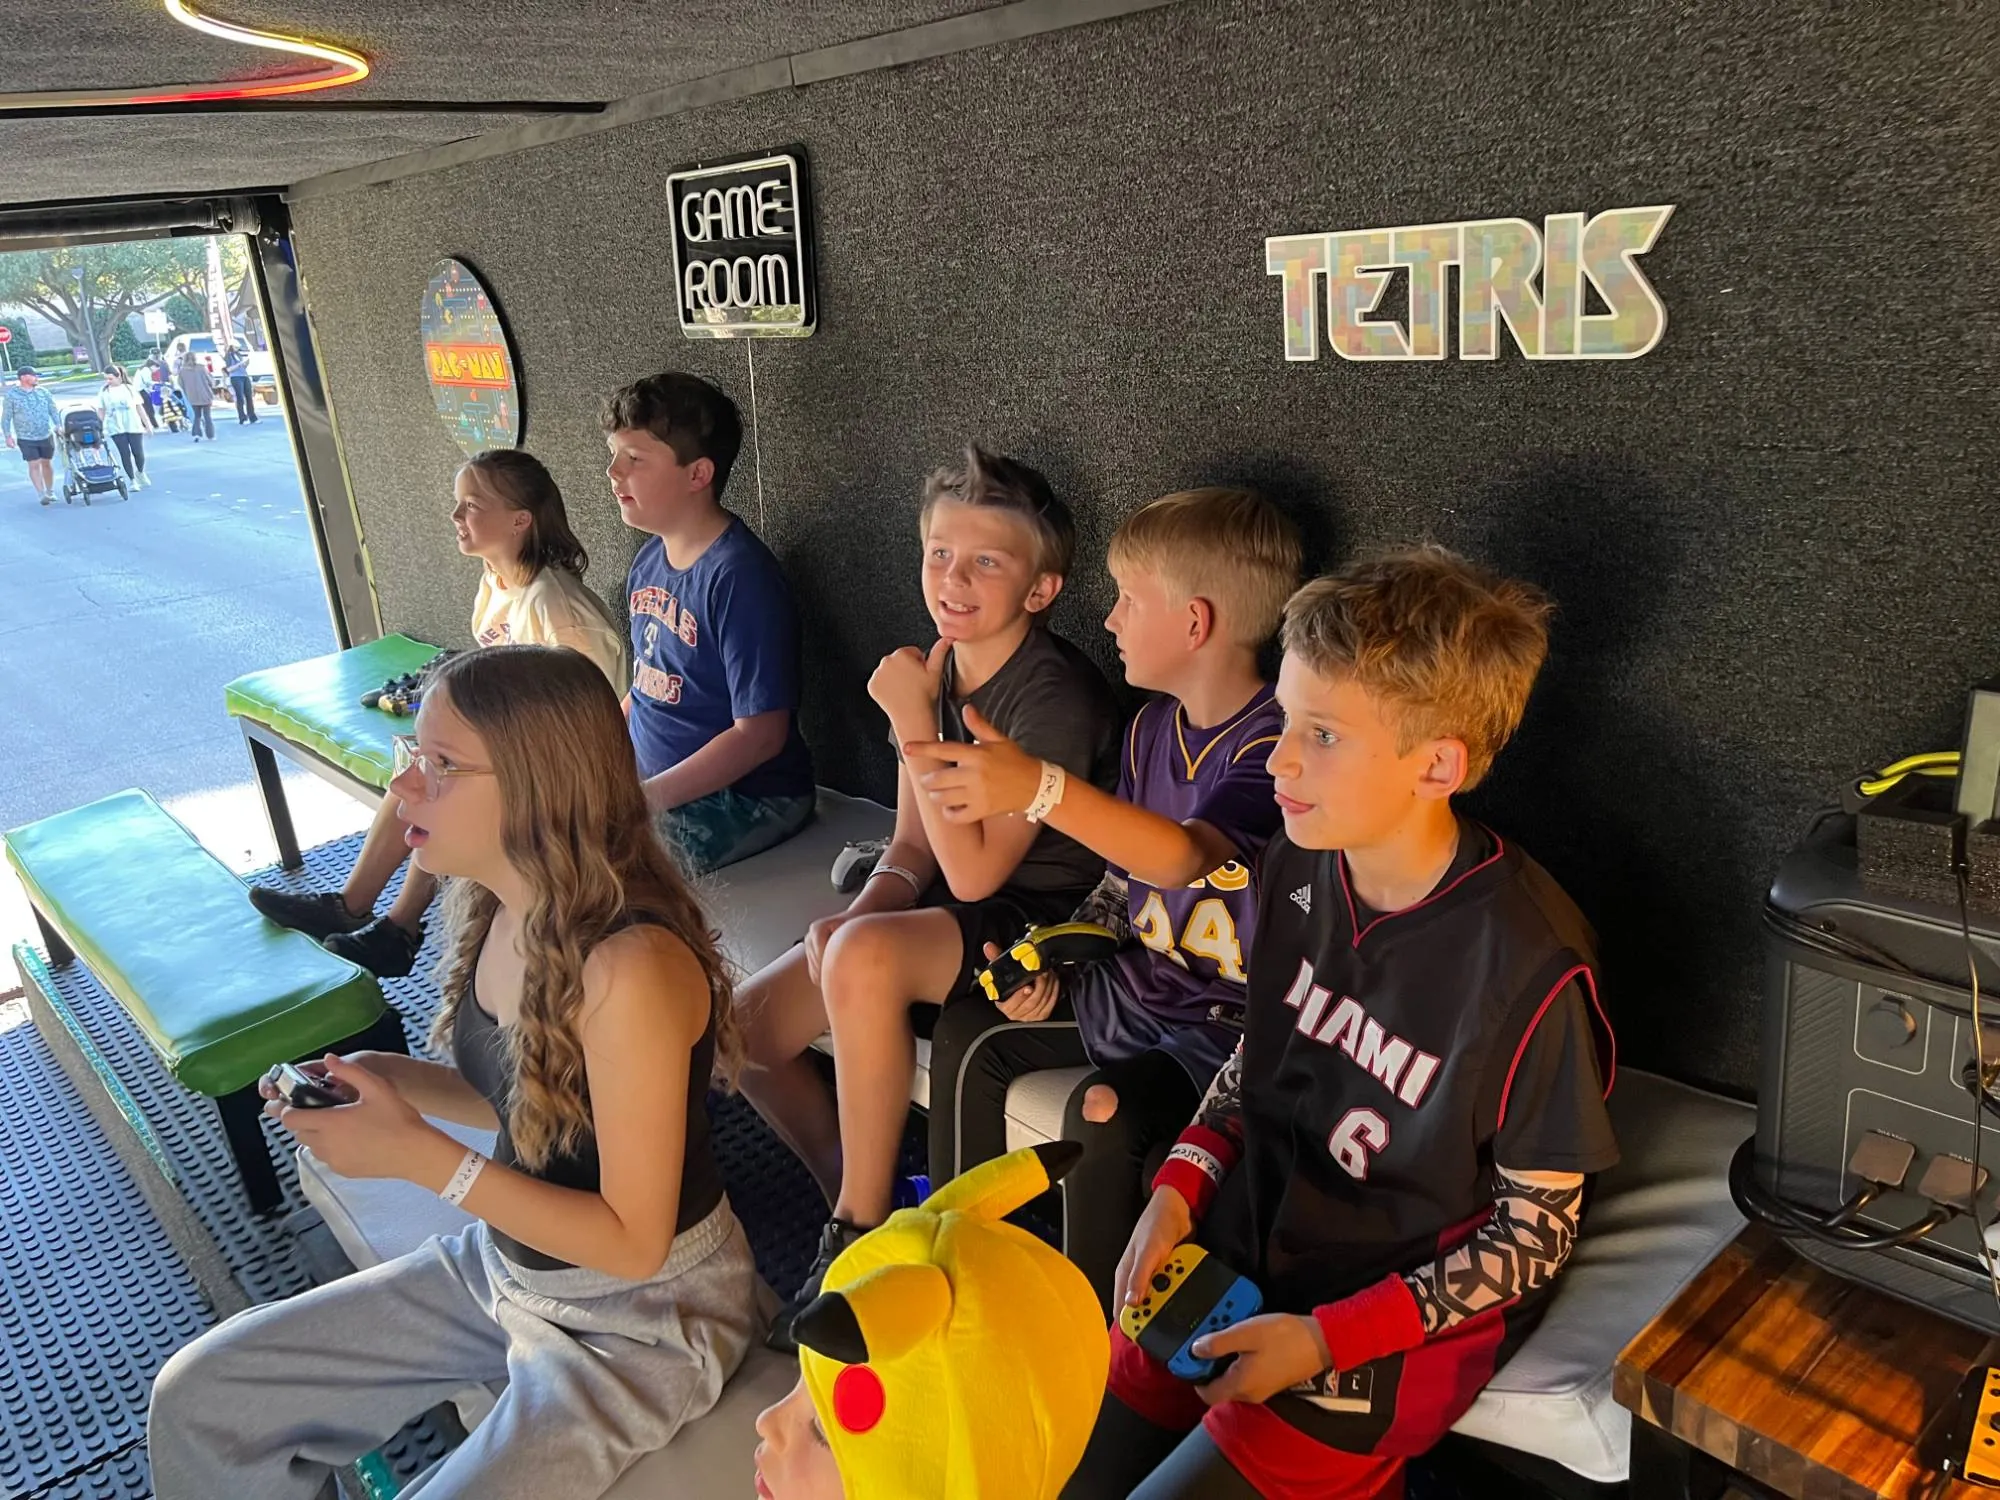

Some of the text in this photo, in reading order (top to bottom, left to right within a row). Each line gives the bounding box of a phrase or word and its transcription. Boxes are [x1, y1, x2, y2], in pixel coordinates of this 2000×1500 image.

[681, 179, 784, 242] GAME
[685, 253, 791, 309] ROOM
[1265, 204, 1677, 361] TETRIS
[430, 349, 505, 381] PAC-MAN
[1327, 1107, 1391, 1182] 6
